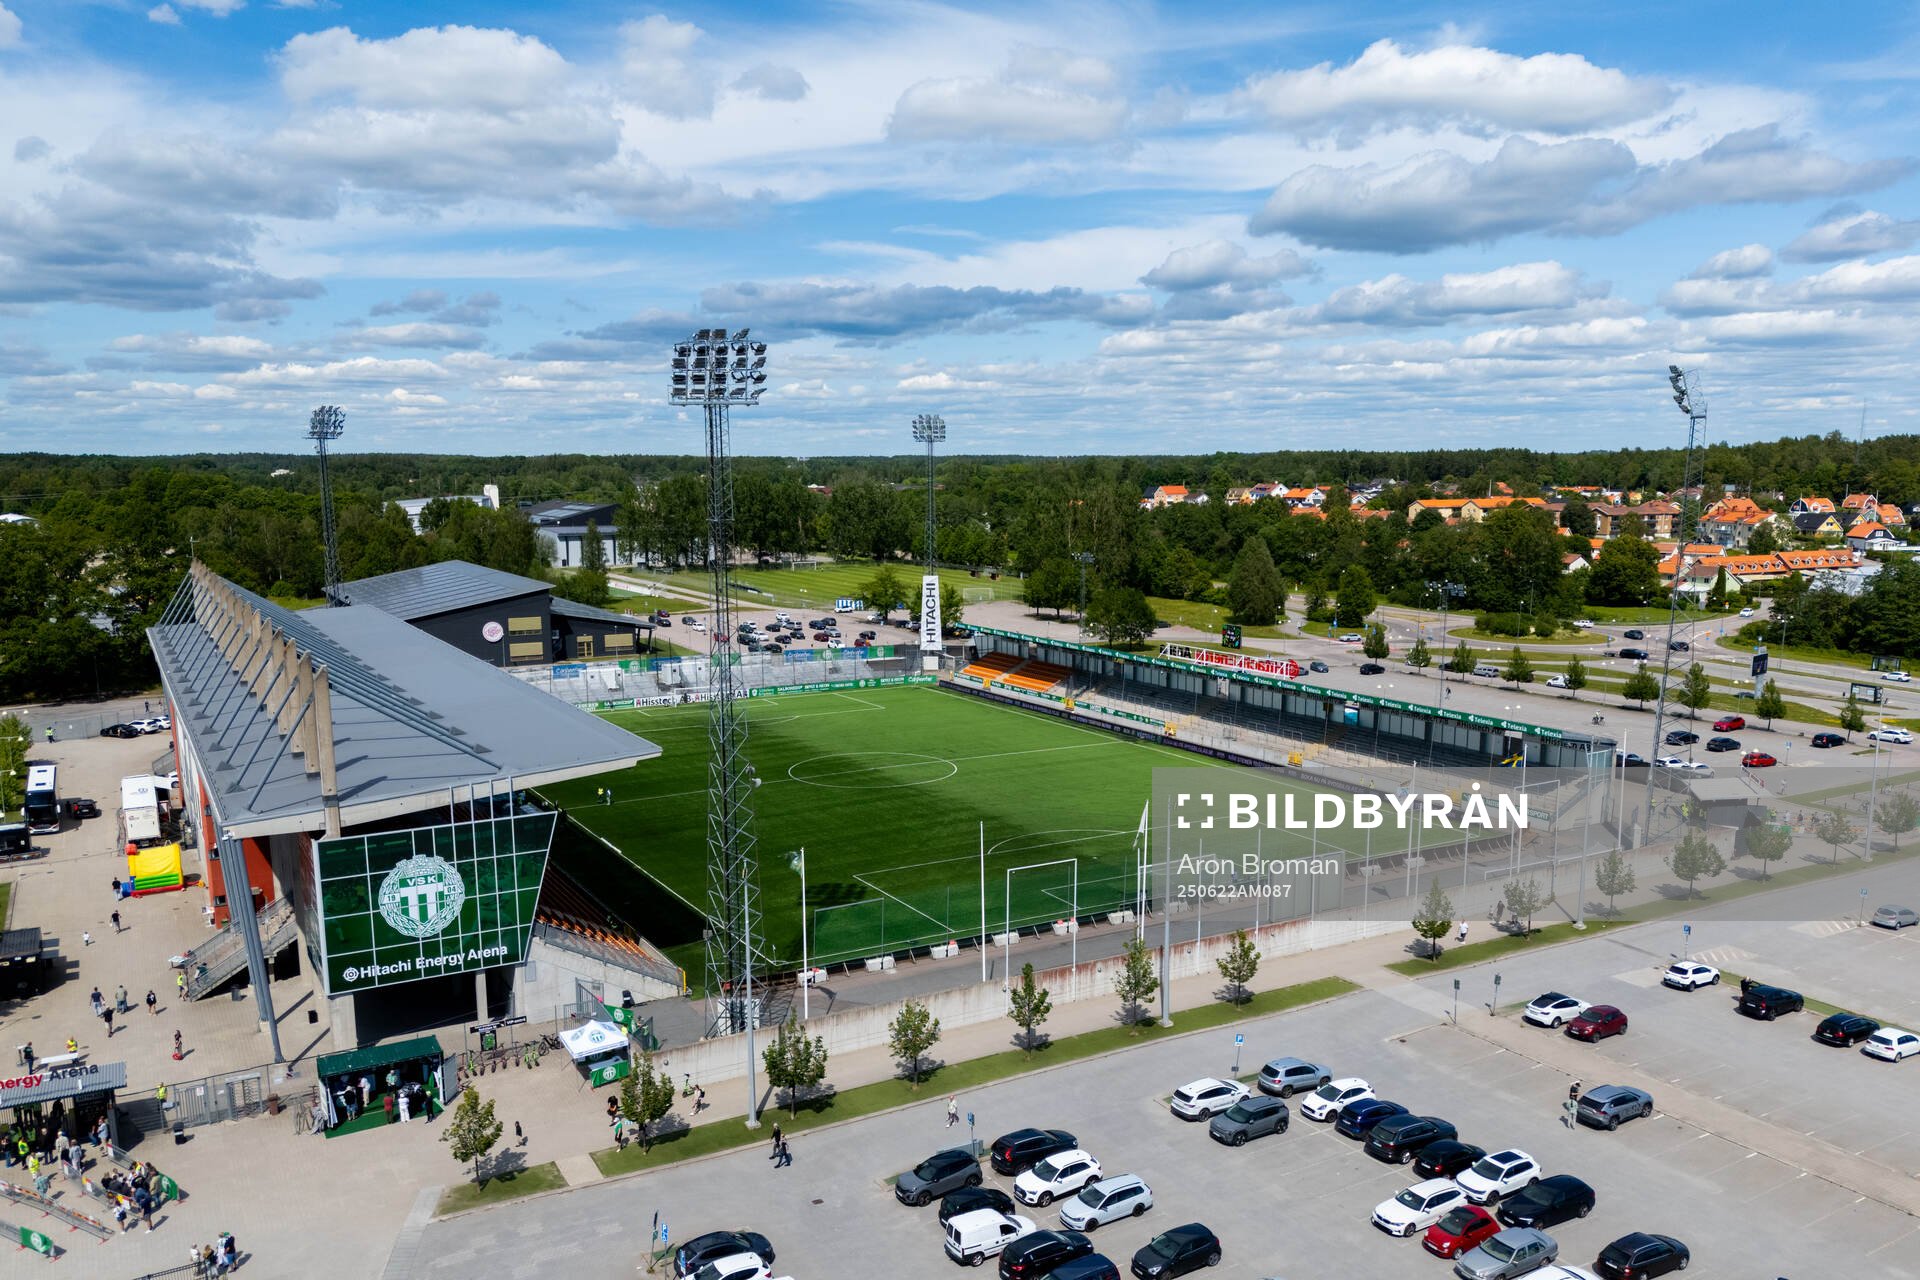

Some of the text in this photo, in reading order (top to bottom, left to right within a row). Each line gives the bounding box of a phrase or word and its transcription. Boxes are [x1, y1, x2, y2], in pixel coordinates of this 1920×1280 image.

[925, 583, 936, 643] HITACHI
[406, 875, 437, 887] VSK
[387, 894, 396, 902] 19
[360, 946, 508, 979] Hitachi Energy Arena
[50, 1064, 99, 1081] Arena
